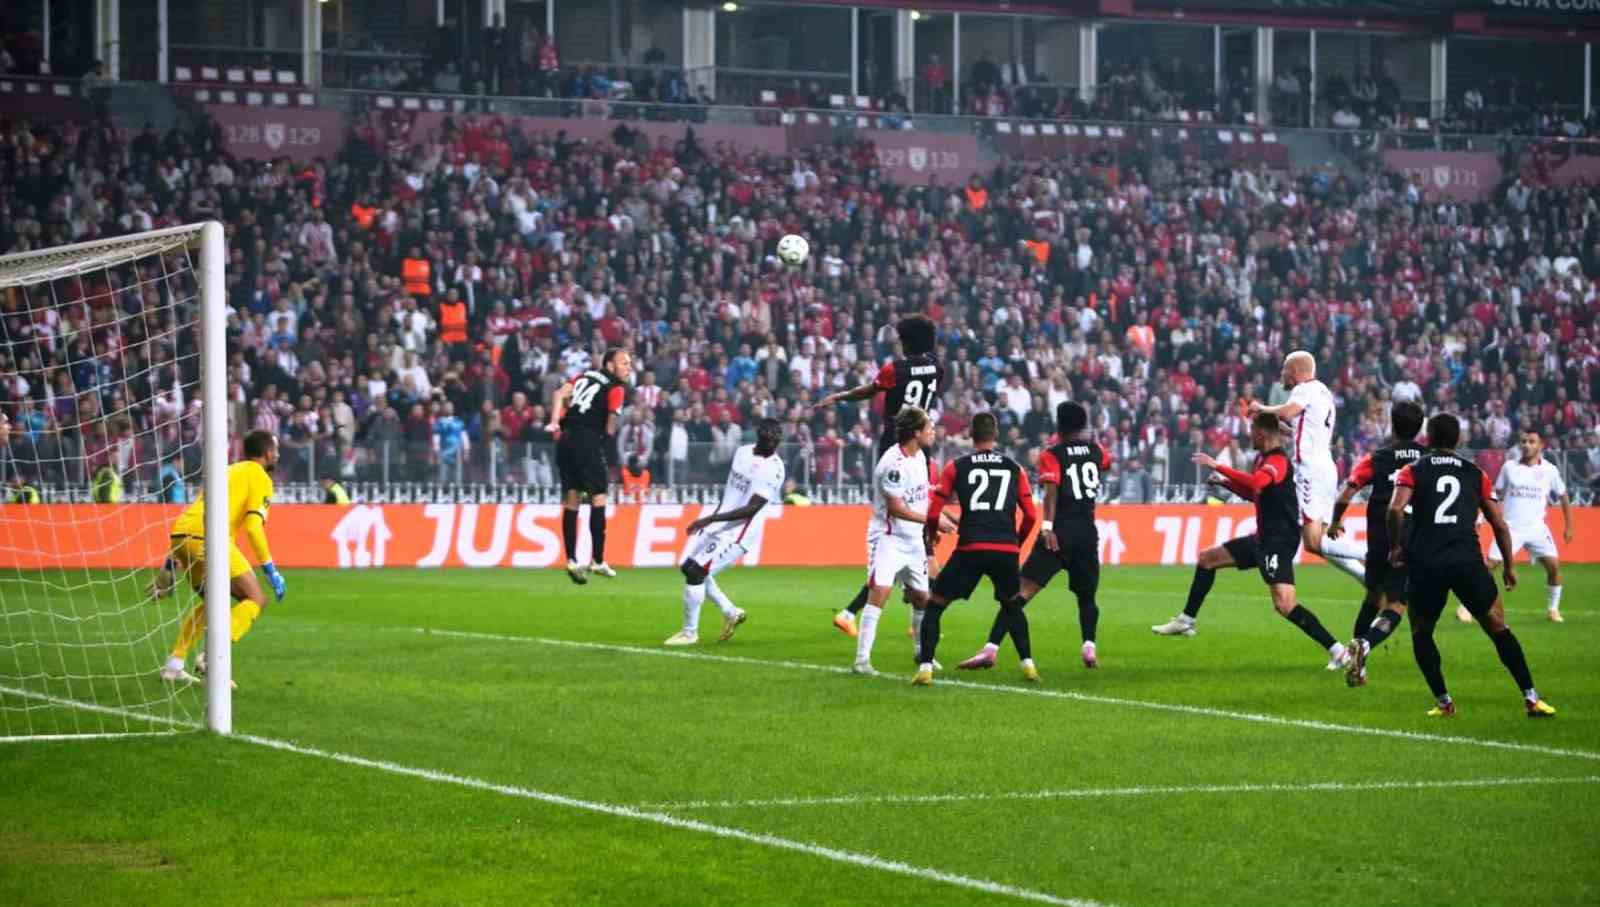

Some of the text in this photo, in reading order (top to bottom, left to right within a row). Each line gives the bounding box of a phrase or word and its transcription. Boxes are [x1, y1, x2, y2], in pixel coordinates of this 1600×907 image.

[288, 127, 320, 145] 129
[967, 468, 1011, 511] 27
[1066, 461, 1099, 500] 19
[1434, 475, 1460, 524] 2
[1264, 553, 1279, 570] 14
